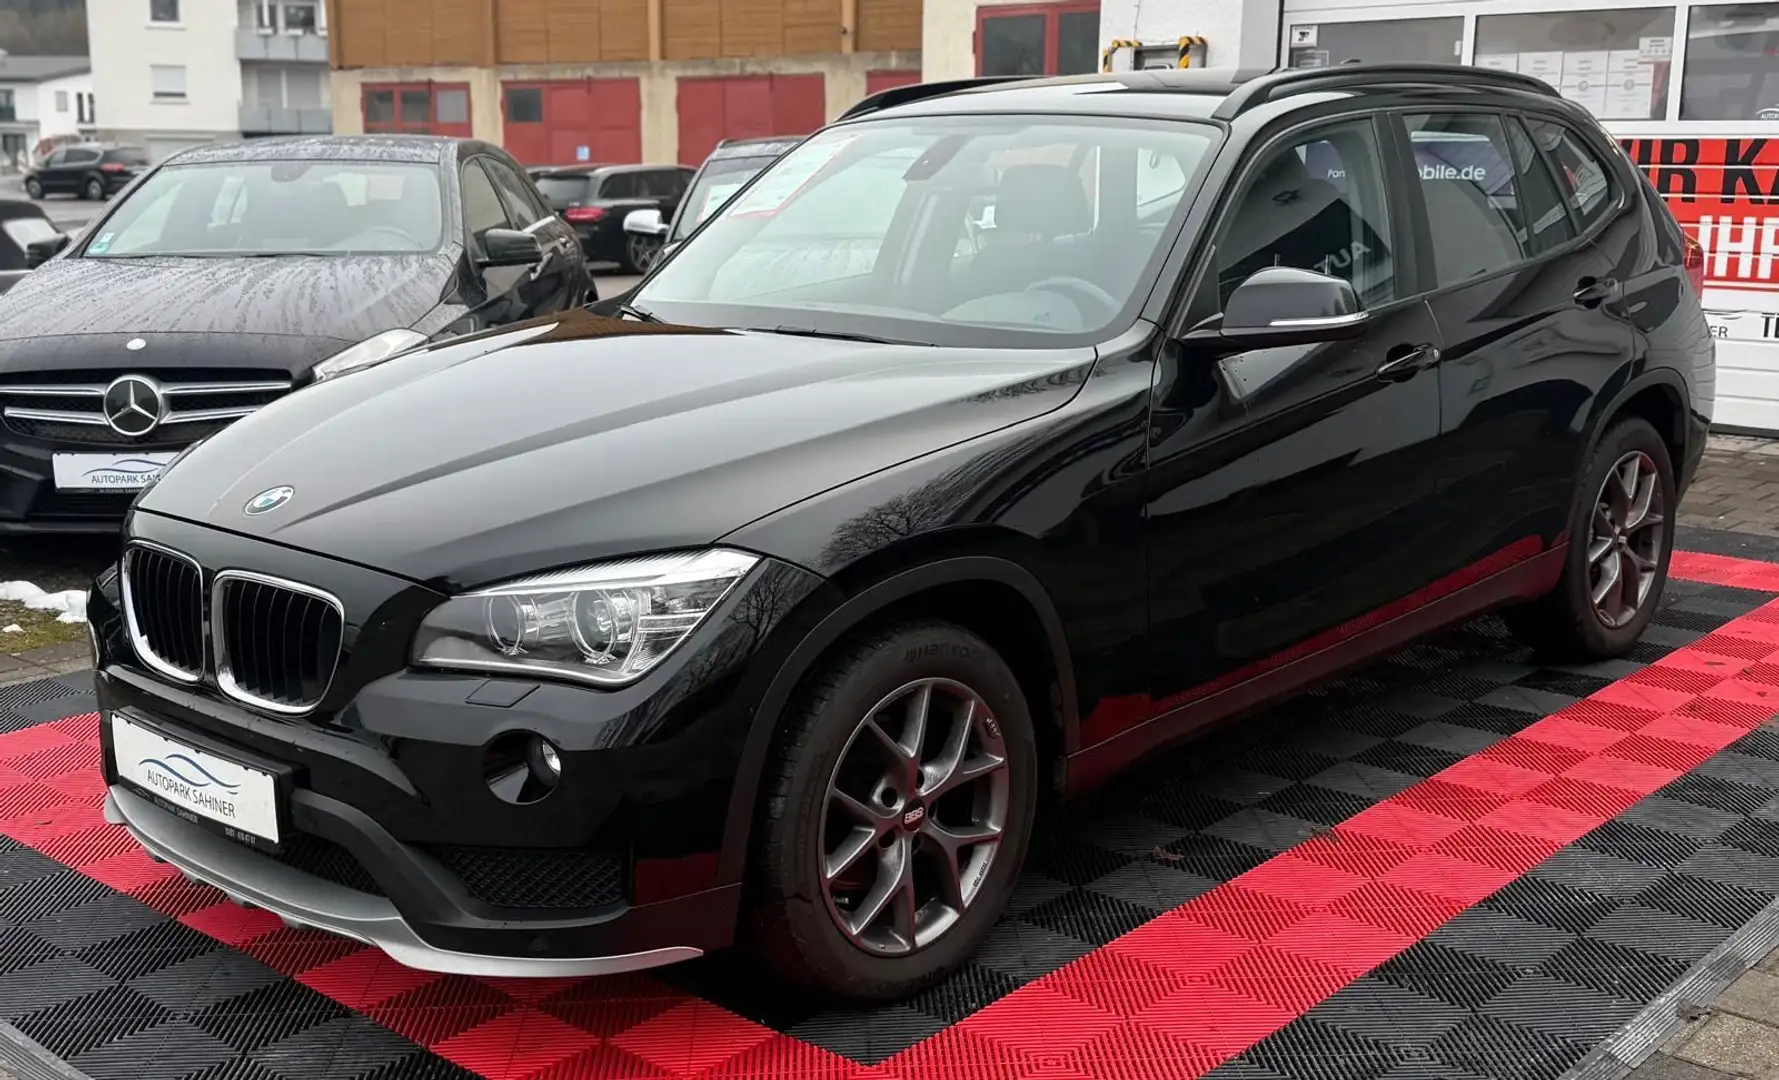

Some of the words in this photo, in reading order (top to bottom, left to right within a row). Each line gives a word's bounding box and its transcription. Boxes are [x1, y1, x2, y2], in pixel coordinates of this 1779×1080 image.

[91, 474, 139, 484] AUTOPARK
[147, 768, 191, 801] AUTOPARK
[192, 789, 236, 819] SAHINER
[904, 806, 924, 825] BBS
